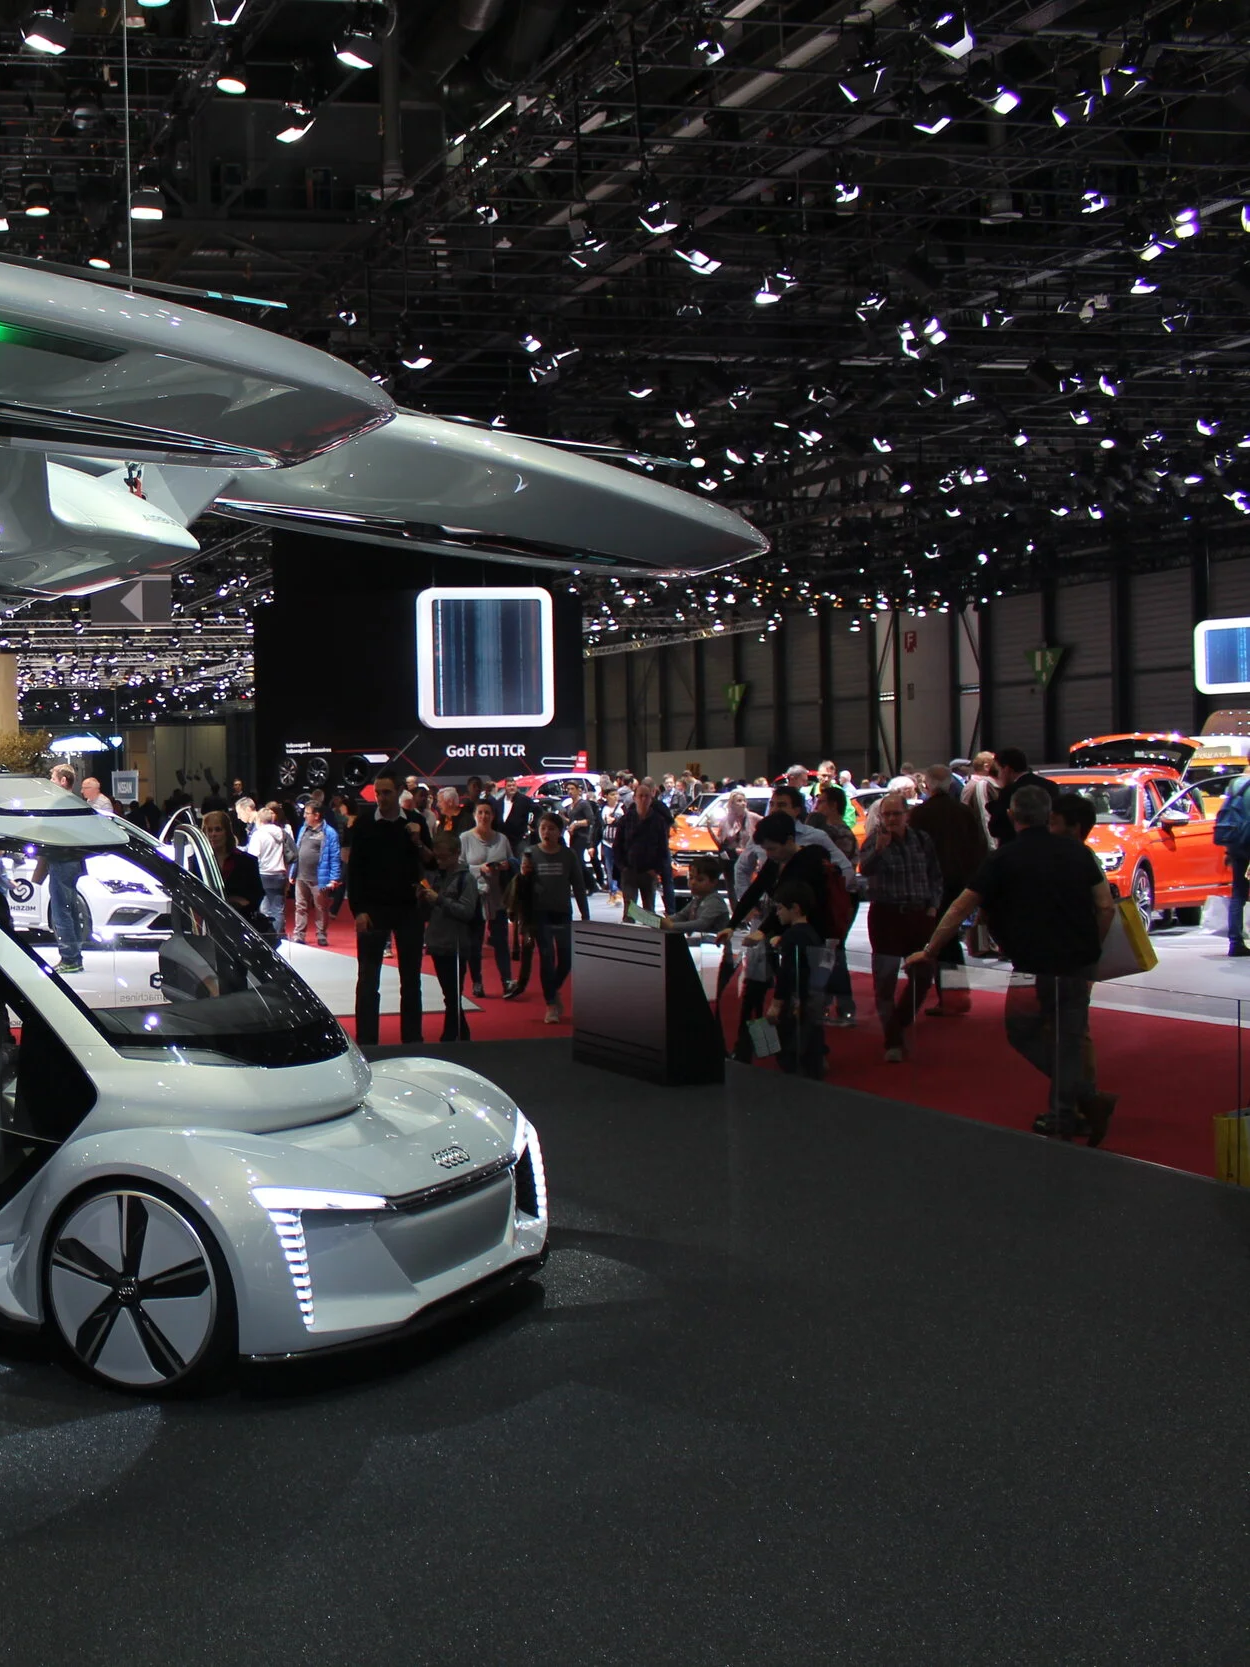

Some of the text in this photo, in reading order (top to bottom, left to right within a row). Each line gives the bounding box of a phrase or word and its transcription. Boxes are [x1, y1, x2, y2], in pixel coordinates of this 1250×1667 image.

[446, 744, 526, 757] Golf GTI TCR
